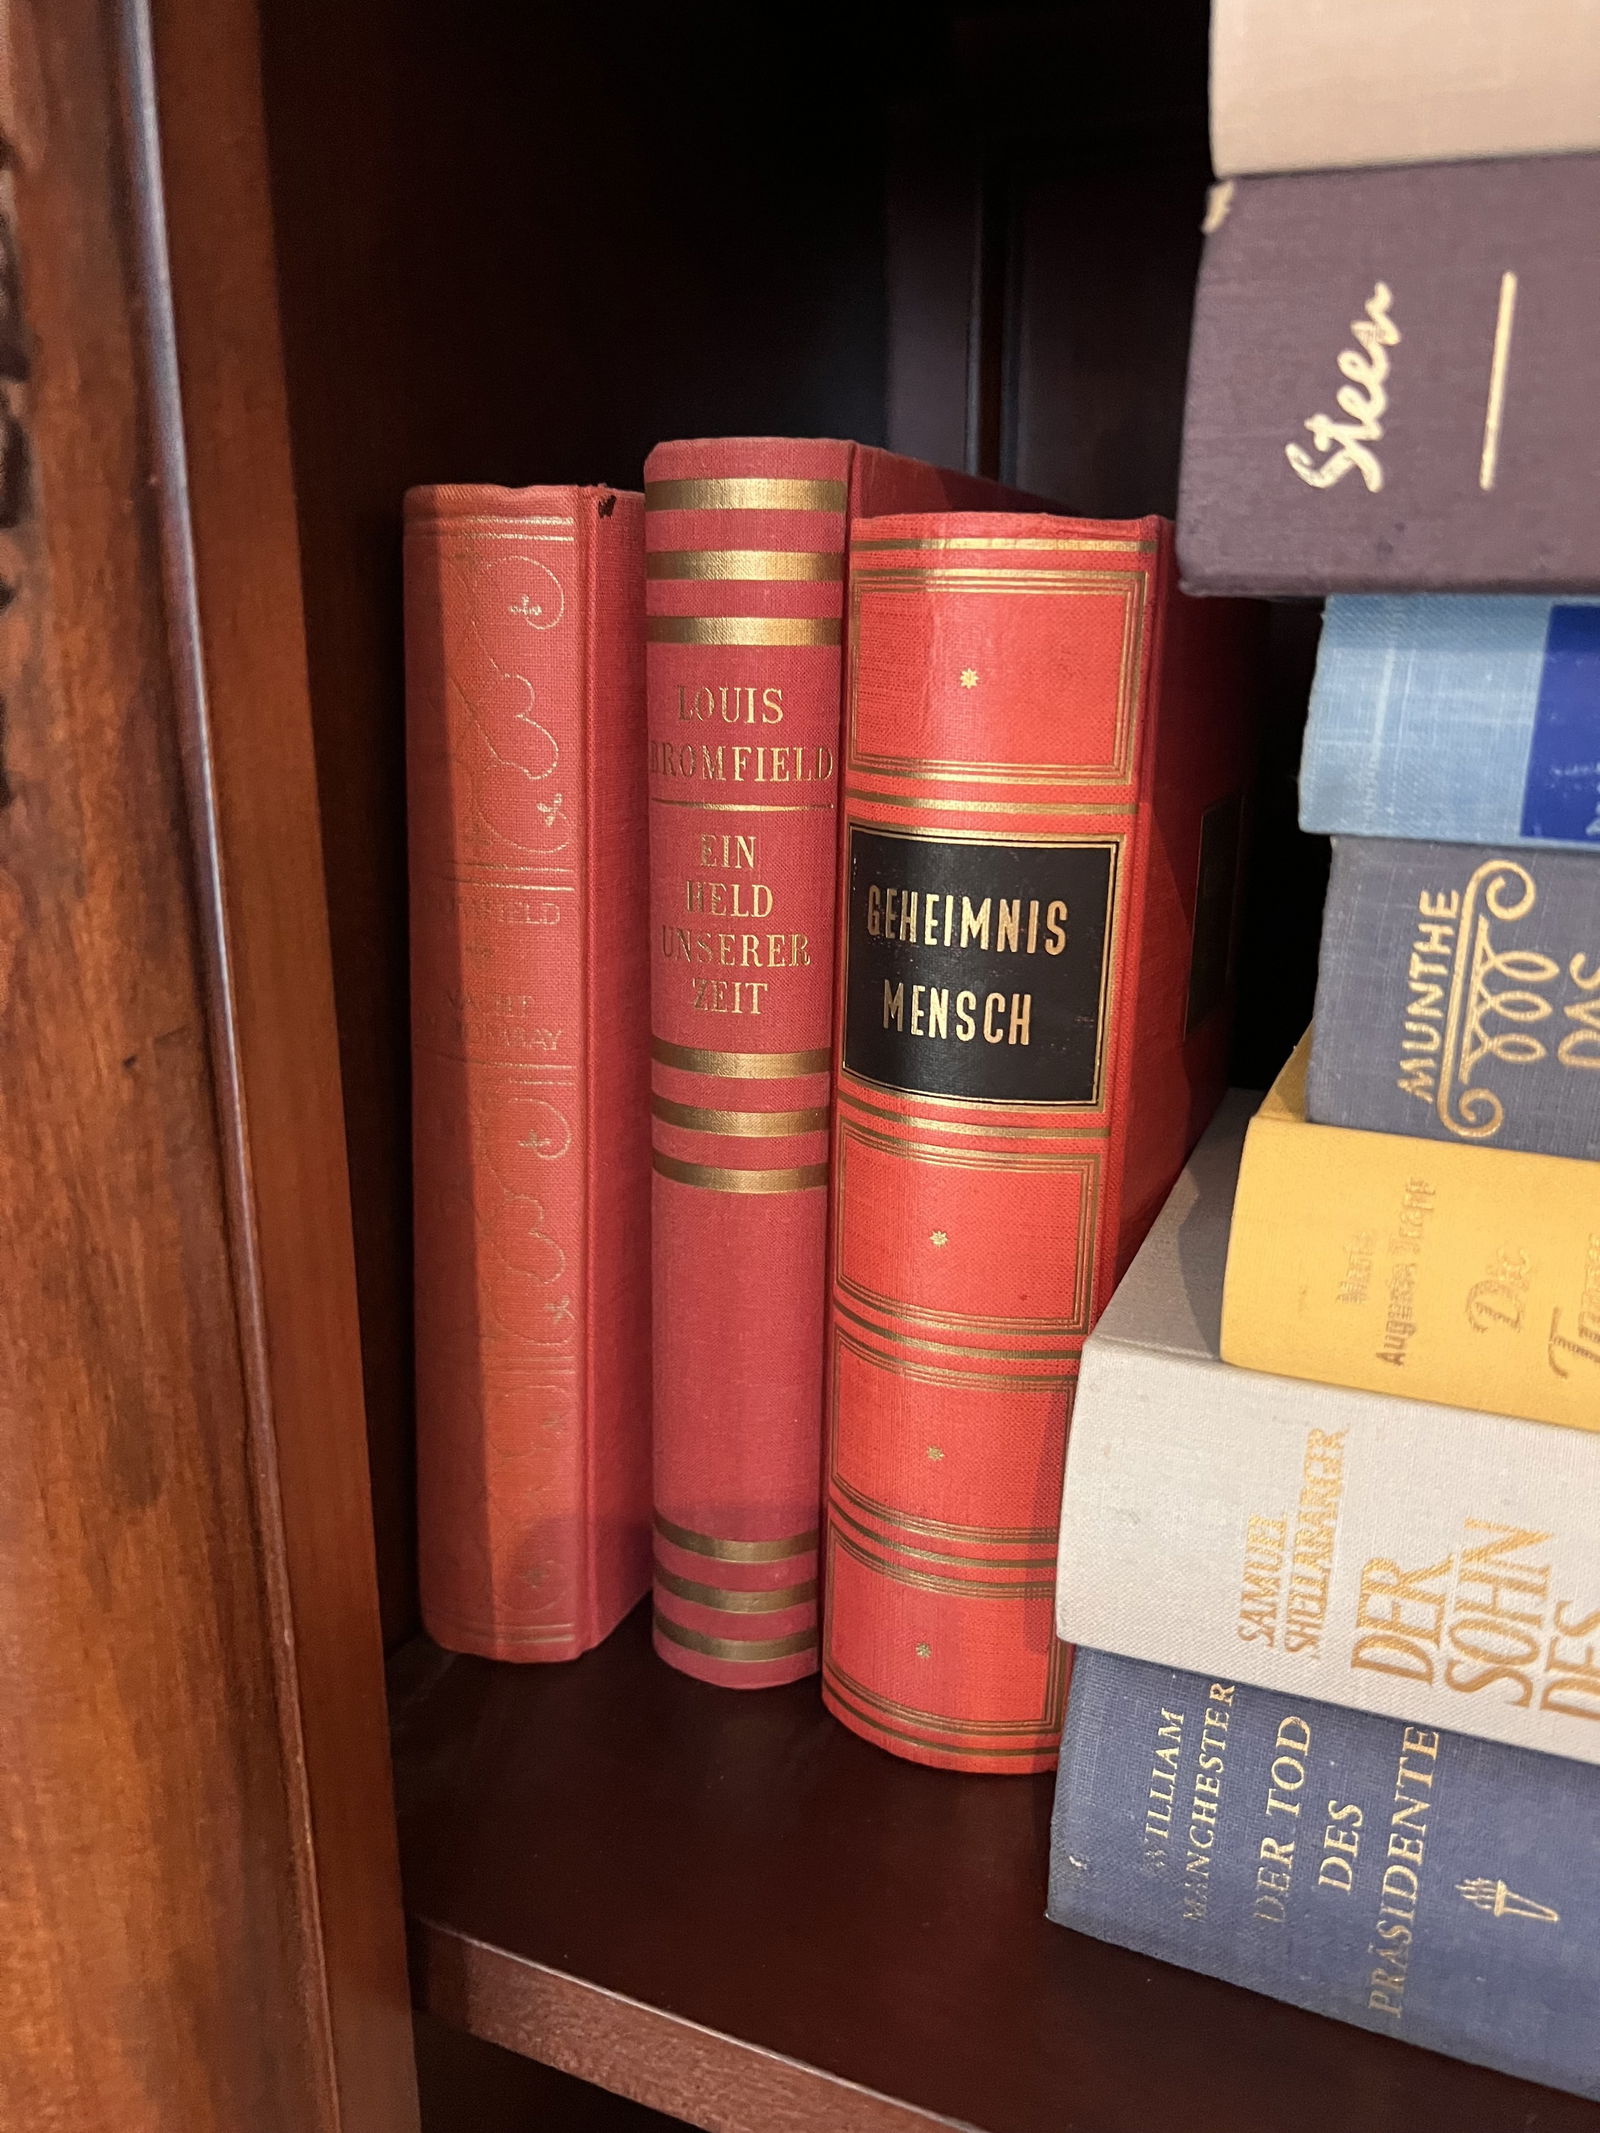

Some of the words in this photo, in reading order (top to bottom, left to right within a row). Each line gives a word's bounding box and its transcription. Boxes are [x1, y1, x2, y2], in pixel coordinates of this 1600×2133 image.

[676, 685, 784, 724] LOUIS
[651, 740, 833, 782] BROMFIELD
[700, 834, 757, 869] EIN
[687, 880, 774, 918] HELD
[867, 884, 1069, 957] GEHEIMNIS
[662, 925, 812, 968] UNSERER
[692, 977, 769, 1015] ZEIT
[883, 979, 1032, 1046] MENSCH
[1397, 889, 1462, 1103] MUNTHE
[1238, 1512, 1287, 1648] SAMUEL
[1444, 1517, 1554, 1708] SOHN
[1351, 1557, 1455, 1686] DER
[1266, 1716, 1312, 1817] TOD
[1253, 1837, 1296, 1923] DER
[1318, 1800, 1363, 1895] DES
